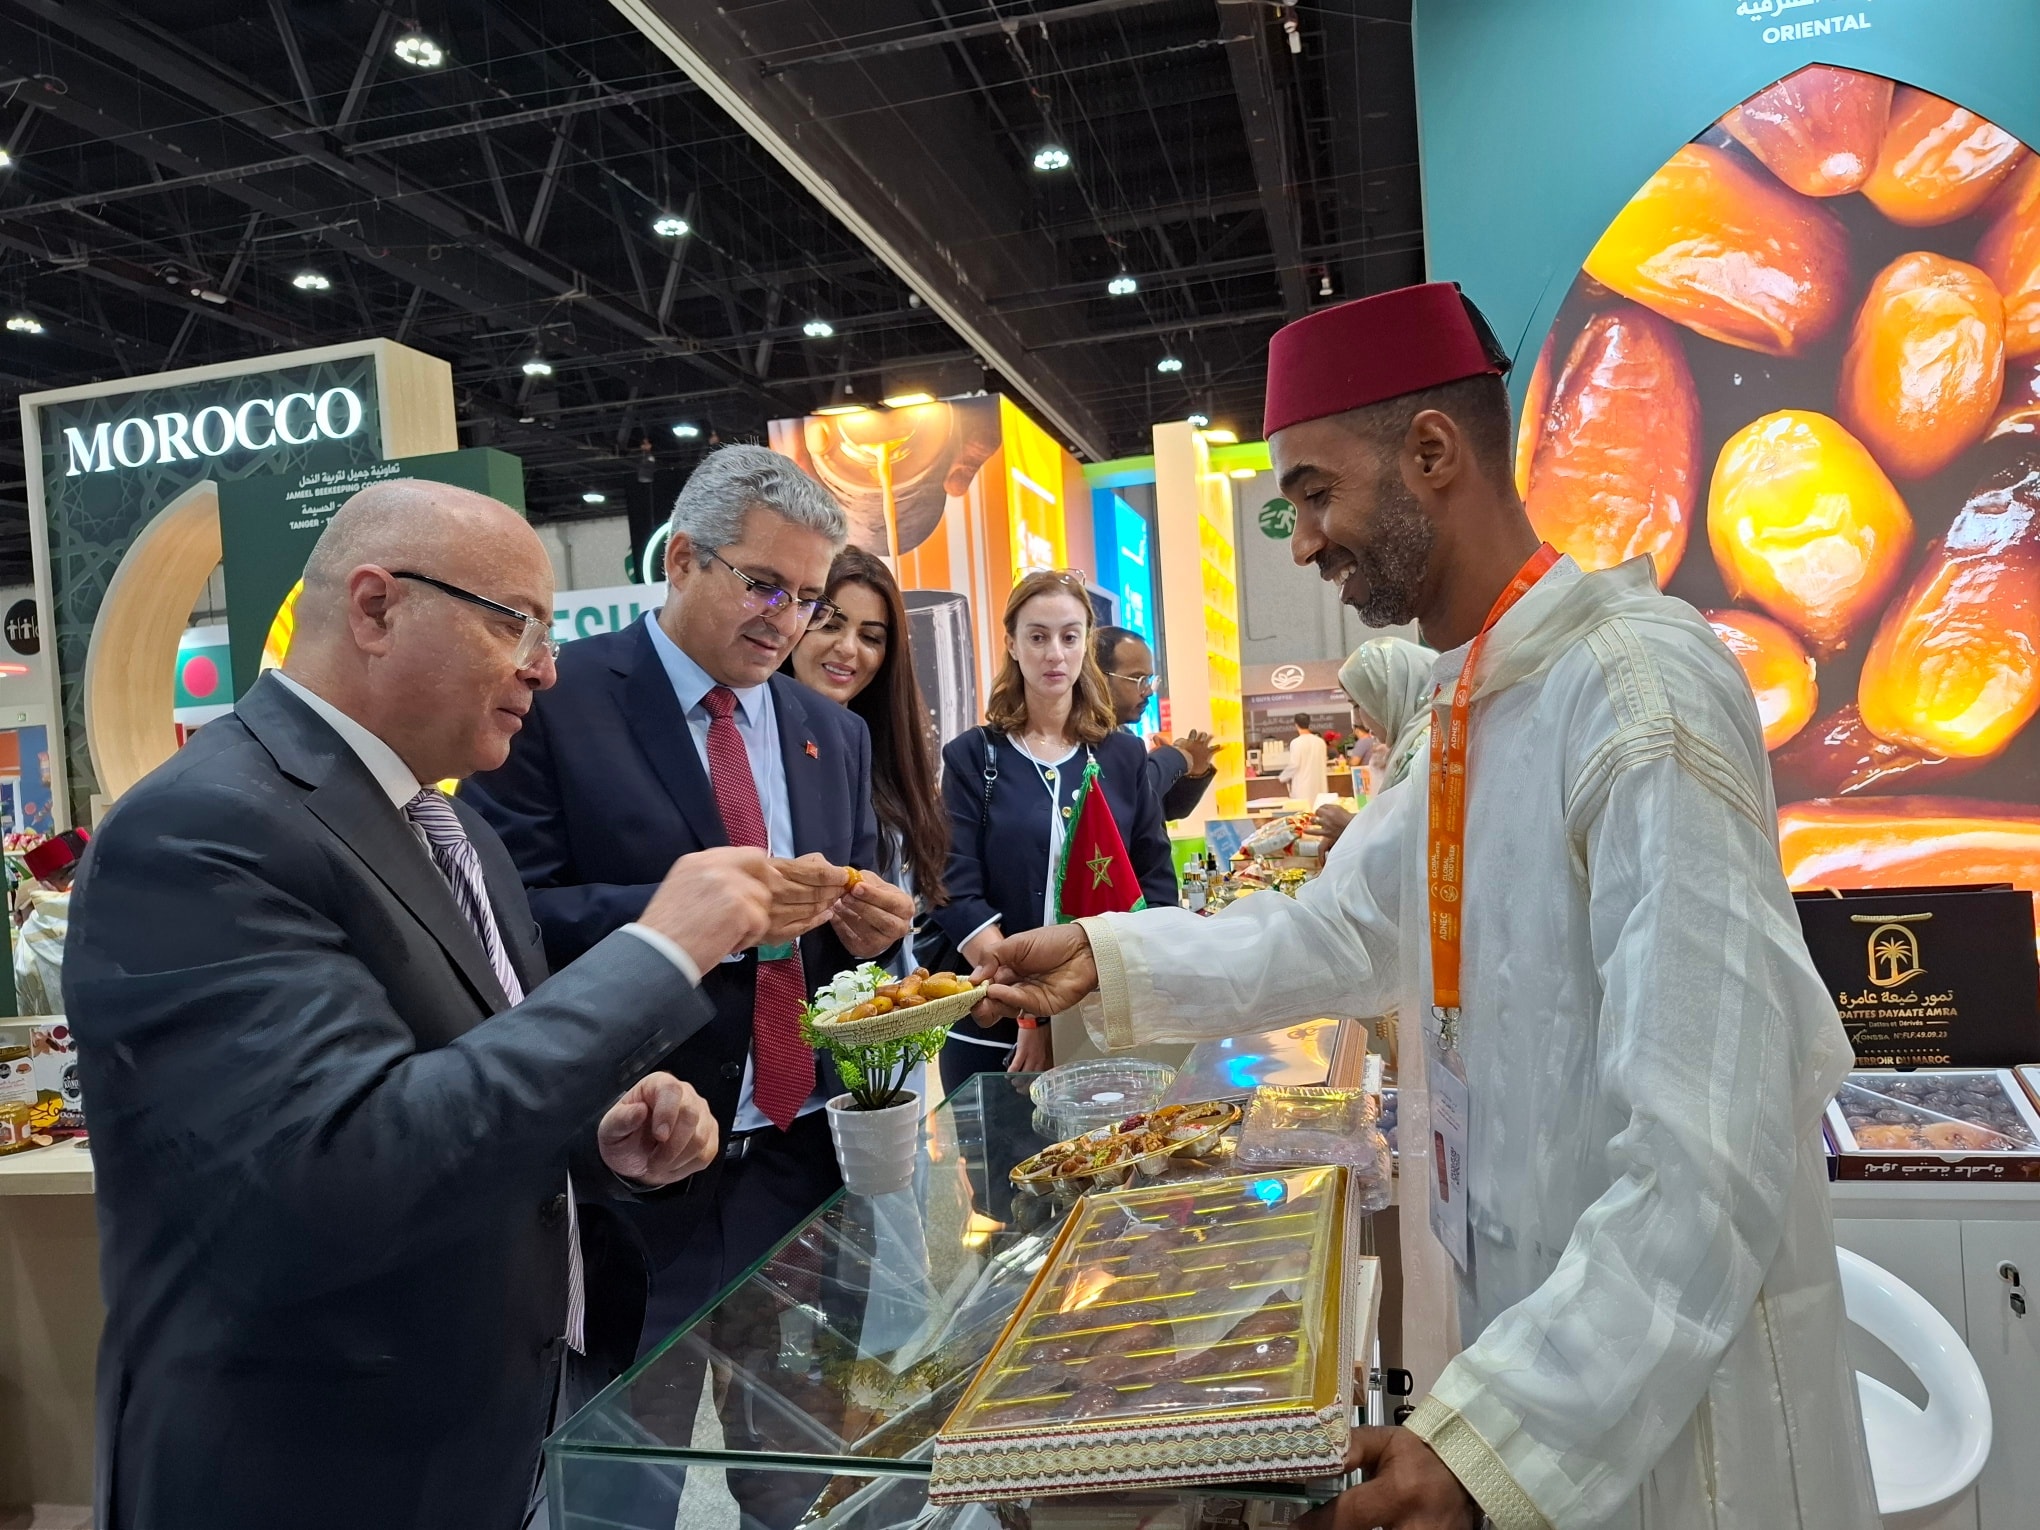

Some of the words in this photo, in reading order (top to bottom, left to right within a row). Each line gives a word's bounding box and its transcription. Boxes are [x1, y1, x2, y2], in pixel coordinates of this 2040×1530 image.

[1762, 12, 1872, 44] ORIENTAL
[63, 386, 362, 477] MOROCCO
[321, 470, 346, 485] لتربية
[346, 469, 370, 482] جميل
[371, 463, 401, 478] تعاونية
[299, 474, 321, 488] النحل
[286, 489, 314, 500] JAMEEL
[315, 484, 360, 496] BEEKEEPING
[301, 501, 335, 517] الحسيمة
[289, 518, 320, 530] TANGER
[1450, 719, 1458, 749] ADNEC
[1448, 844, 1456, 863] WEEK
[1447, 864, 1455, 882] FOOD
[1439, 912, 1448, 941] ADNEC
[1839, 989, 1879, 1009] عامرة
[1880, 990, 1918, 1006] ضيعة
[1921, 989, 1954, 1007] تمور
[1839, 1010, 1877, 1019] DATTES
[1878, 1008, 1925, 1018] DAYAATE
[1925, 1007, 1958, 1017] AMRA
[1855, 1056, 1894, 1066] TERROIR
[1895, 1056, 1912, 1065] DU
[1913, 1055, 1952, 1065] MAROC
[1864, 1162, 1899, 1177] تمور
[1901, 1161, 1951, 1177] ضيعة
[1954, 1166, 2005, 1178] عامرة
